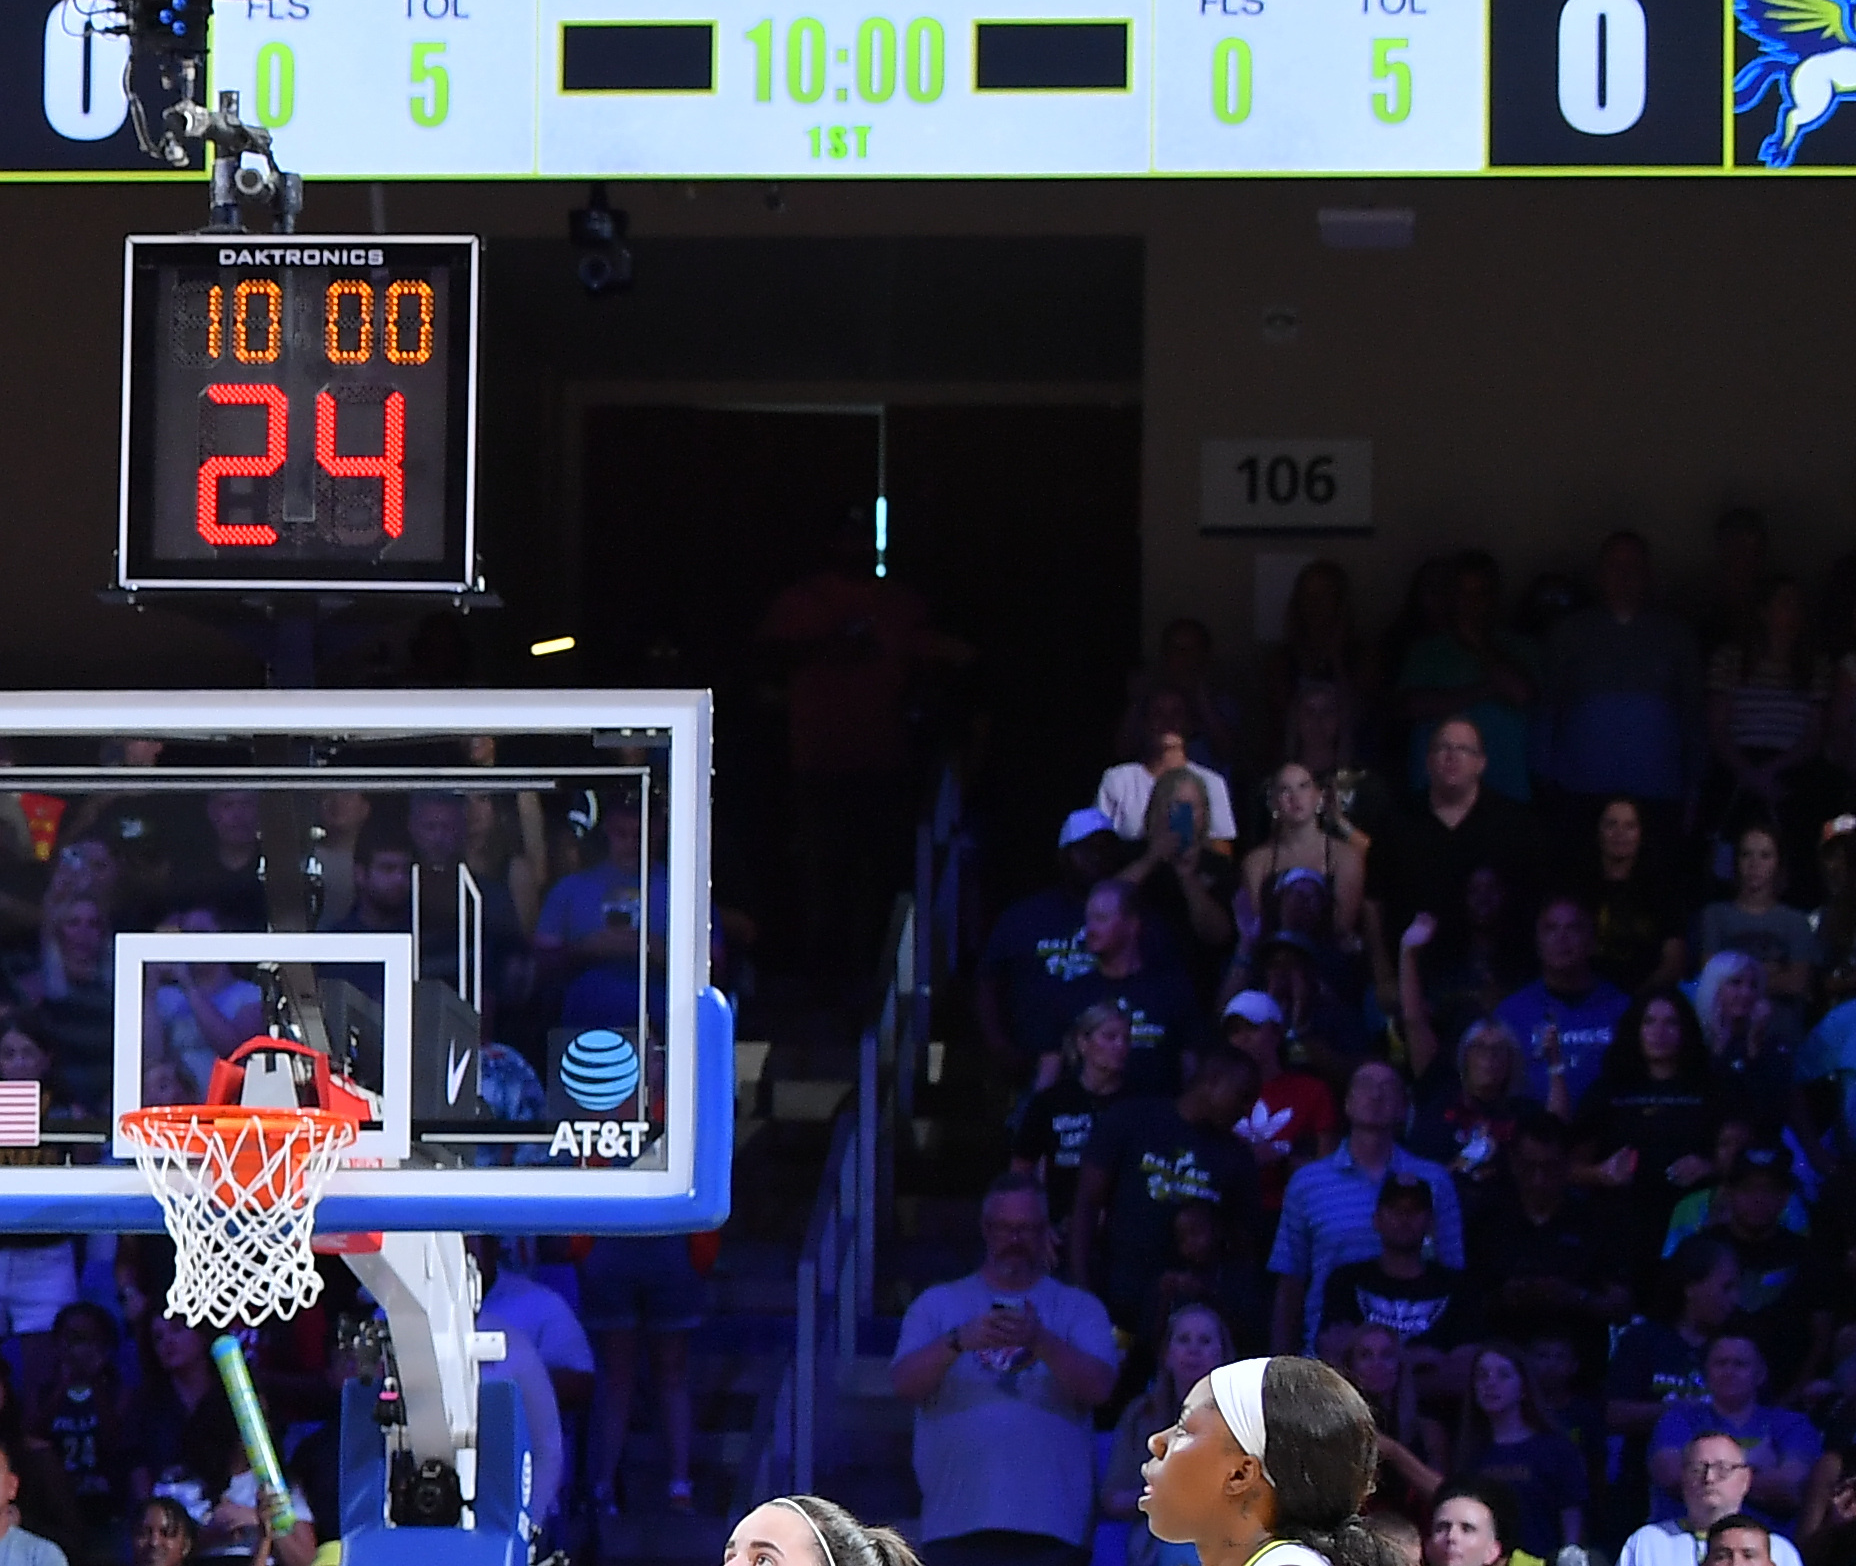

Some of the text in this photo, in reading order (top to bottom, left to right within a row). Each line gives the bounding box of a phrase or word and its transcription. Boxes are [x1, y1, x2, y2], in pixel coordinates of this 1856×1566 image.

[256, 41, 295, 128] 0
[408, 42, 450, 127] 5
[745, 17, 945, 104] 10:00
[1212, 38, 1253, 126] 0
[1371, 37, 1413, 125] 5
[1557, 0, 1647, 137] 0
[808, 126, 873, 160] 1ST
[218, 248, 385, 268] DAKTRONICS
[196, 384, 406, 547] 24
[1235, 457, 1338, 506] 106
[548, 1121, 649, 1158] AT&T
